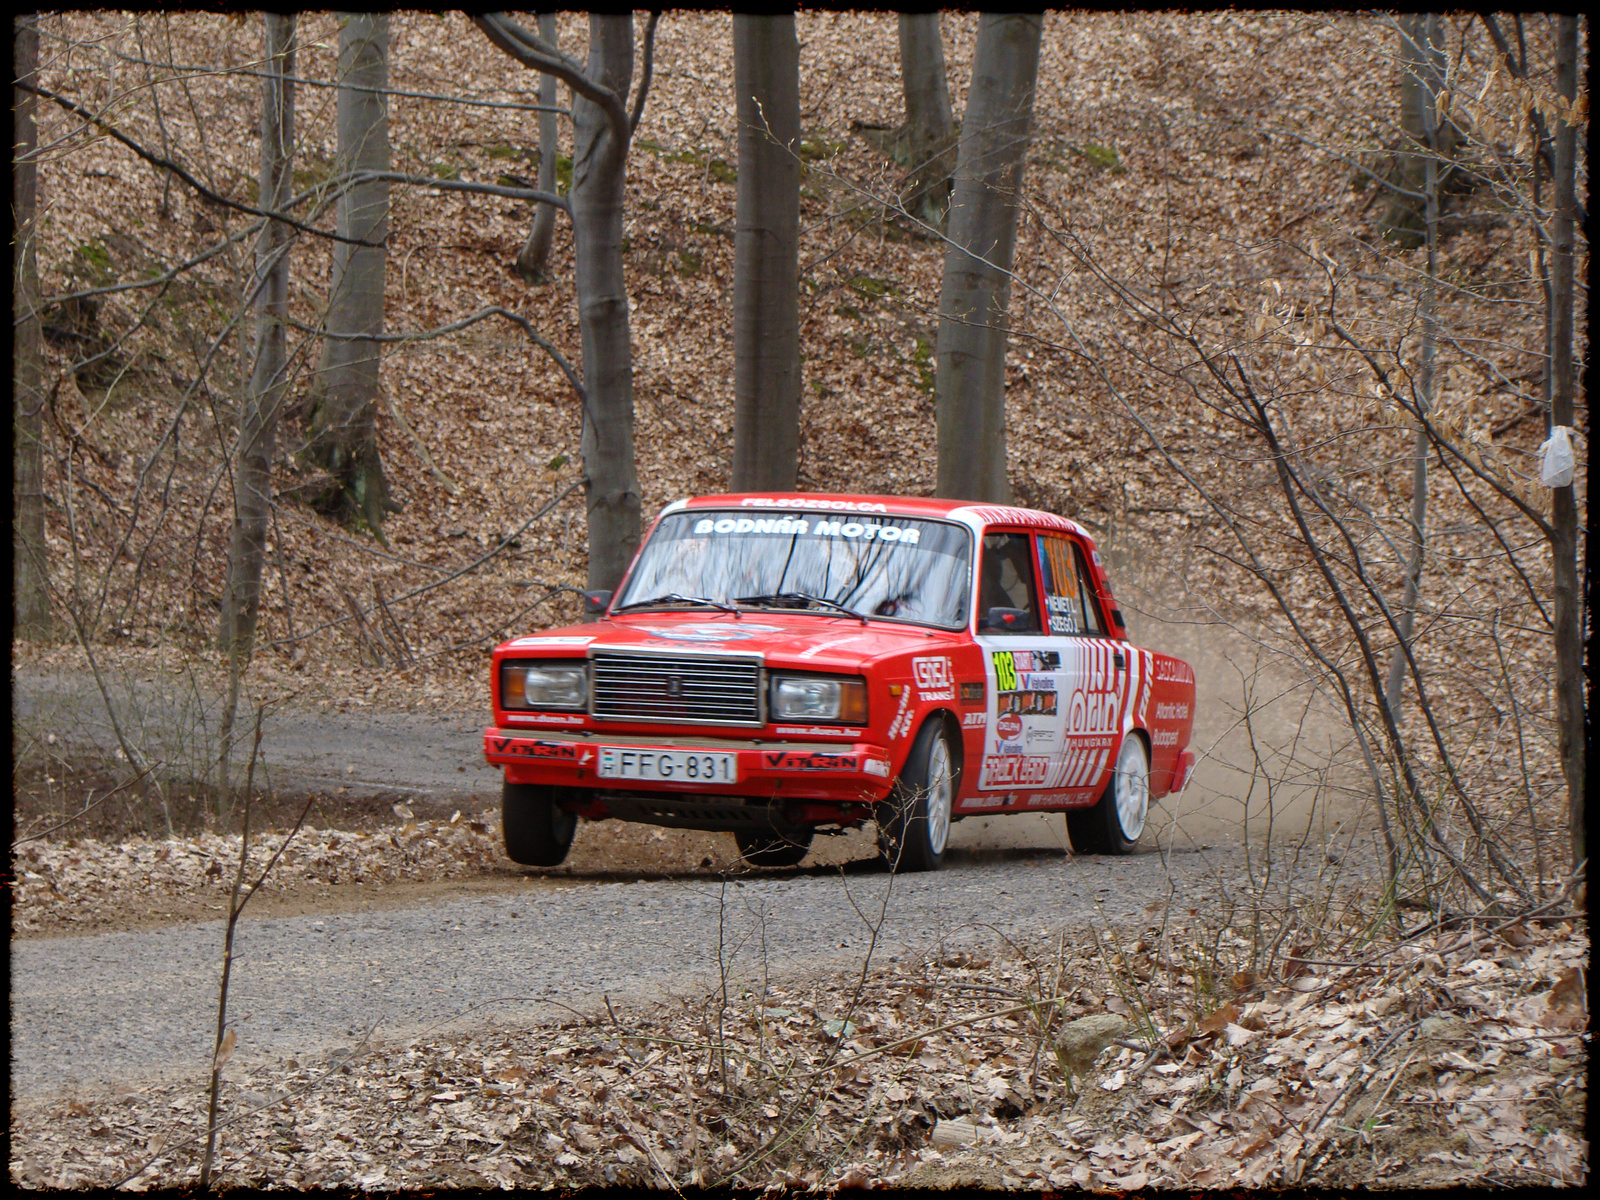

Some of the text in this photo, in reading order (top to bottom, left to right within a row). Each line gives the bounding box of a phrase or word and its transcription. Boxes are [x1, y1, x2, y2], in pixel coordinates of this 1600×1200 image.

[693, 516, 921, 544] BODNÁR MOTOR
[1044, 531, 1076, 598] 103
[993, 652, 1017, 691] 103
[918, 691, 951, 701] TRANS
[1175, 703, 1190, 719] Hotel
[1071, 738, 1113, 748] HUNGARY
[1153, 728, 1179, 748] Budapest
[620, 752, 729, 779] FFG-831
